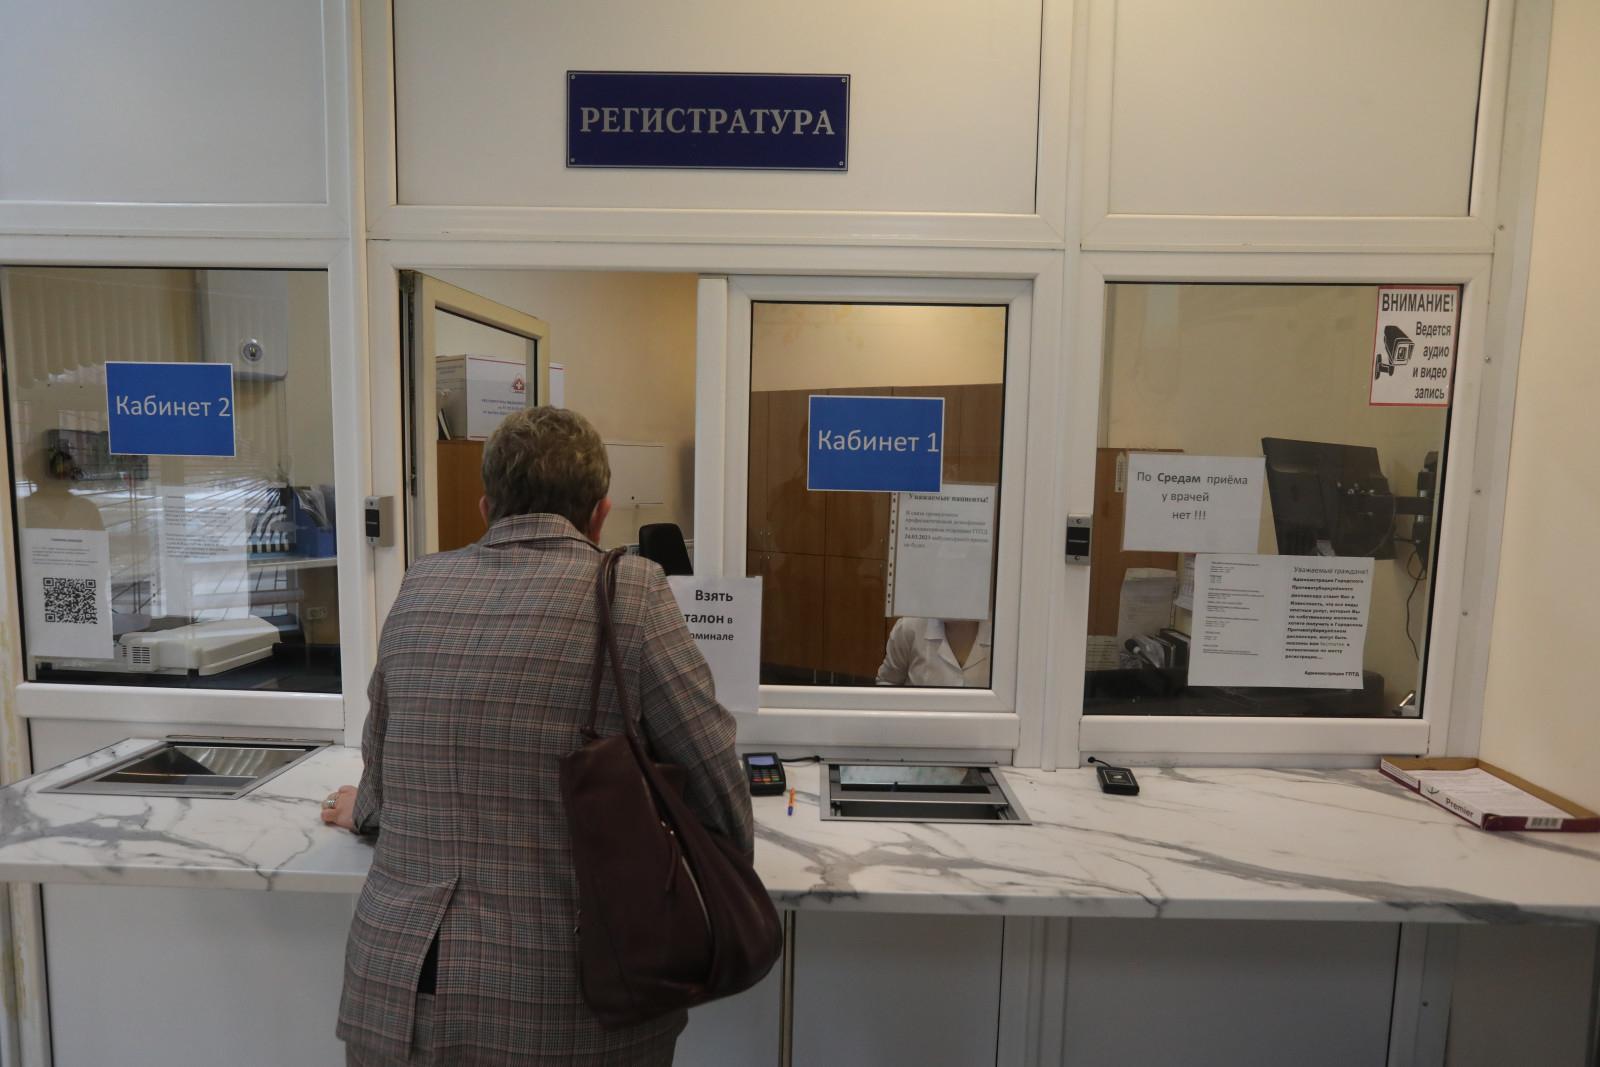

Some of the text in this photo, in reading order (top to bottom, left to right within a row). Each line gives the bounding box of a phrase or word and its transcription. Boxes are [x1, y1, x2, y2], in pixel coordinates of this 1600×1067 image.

[579, 106, 836, 136] РЕГИСТРАТУРА
[1381, 293, 1454, 312] ВНИМАНИЕ!
[1415, 320, 1452, 338] Ведется
[1422, 345, 1450, 360] аудио
[1412, 367, 1448, 380] и видео
[1414, 387, 1445, 399] запись
[116, 394, 231, 417] Кабинет 2
[818, 429, 940, 453] Кабинет 1
[1137, 471, 1248, 486] По Средам приёма
[1161, 492, 1209, 502] у врачей
[1172, 511, 1191, 520] нет
[695, 589, 734, 602] Взять
[684, 613, 724, 624] талон
[1445, 797, 1474, 818] Premier
